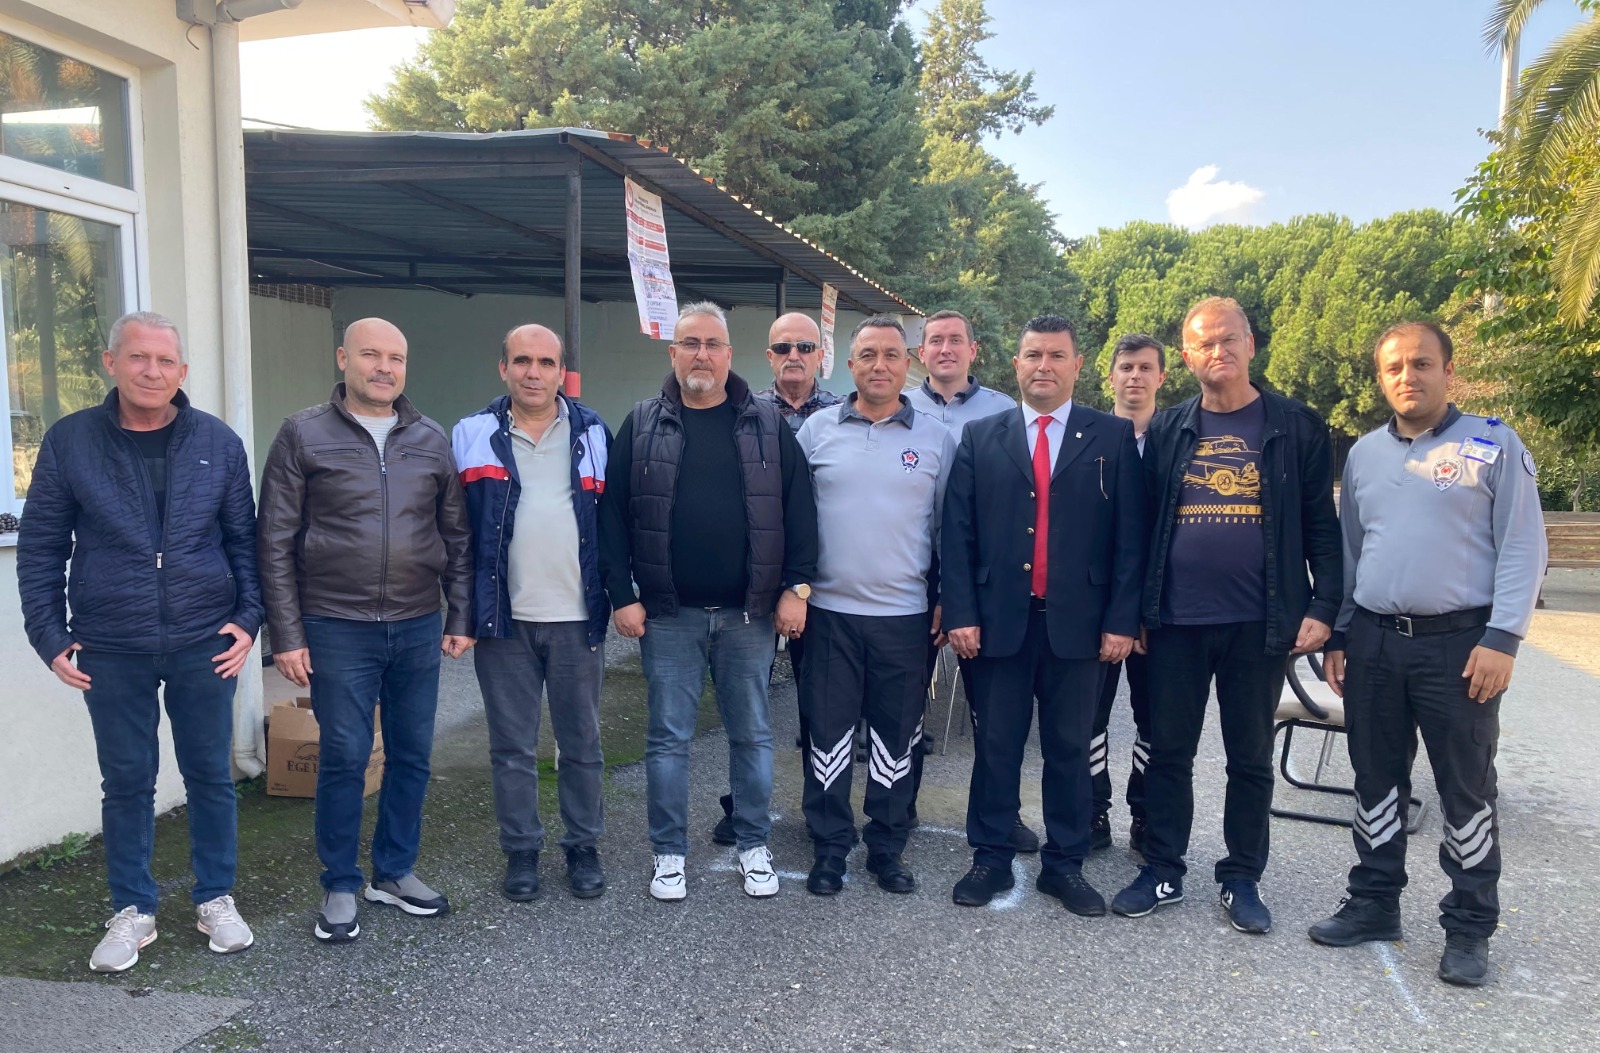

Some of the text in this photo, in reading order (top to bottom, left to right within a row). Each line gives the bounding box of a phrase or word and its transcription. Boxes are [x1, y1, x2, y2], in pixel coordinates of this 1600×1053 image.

[1230, 505, 1250, 514] NYC
[1207, 516, 1247, 524] THERE
[287, 760, 310, 773] EGE
